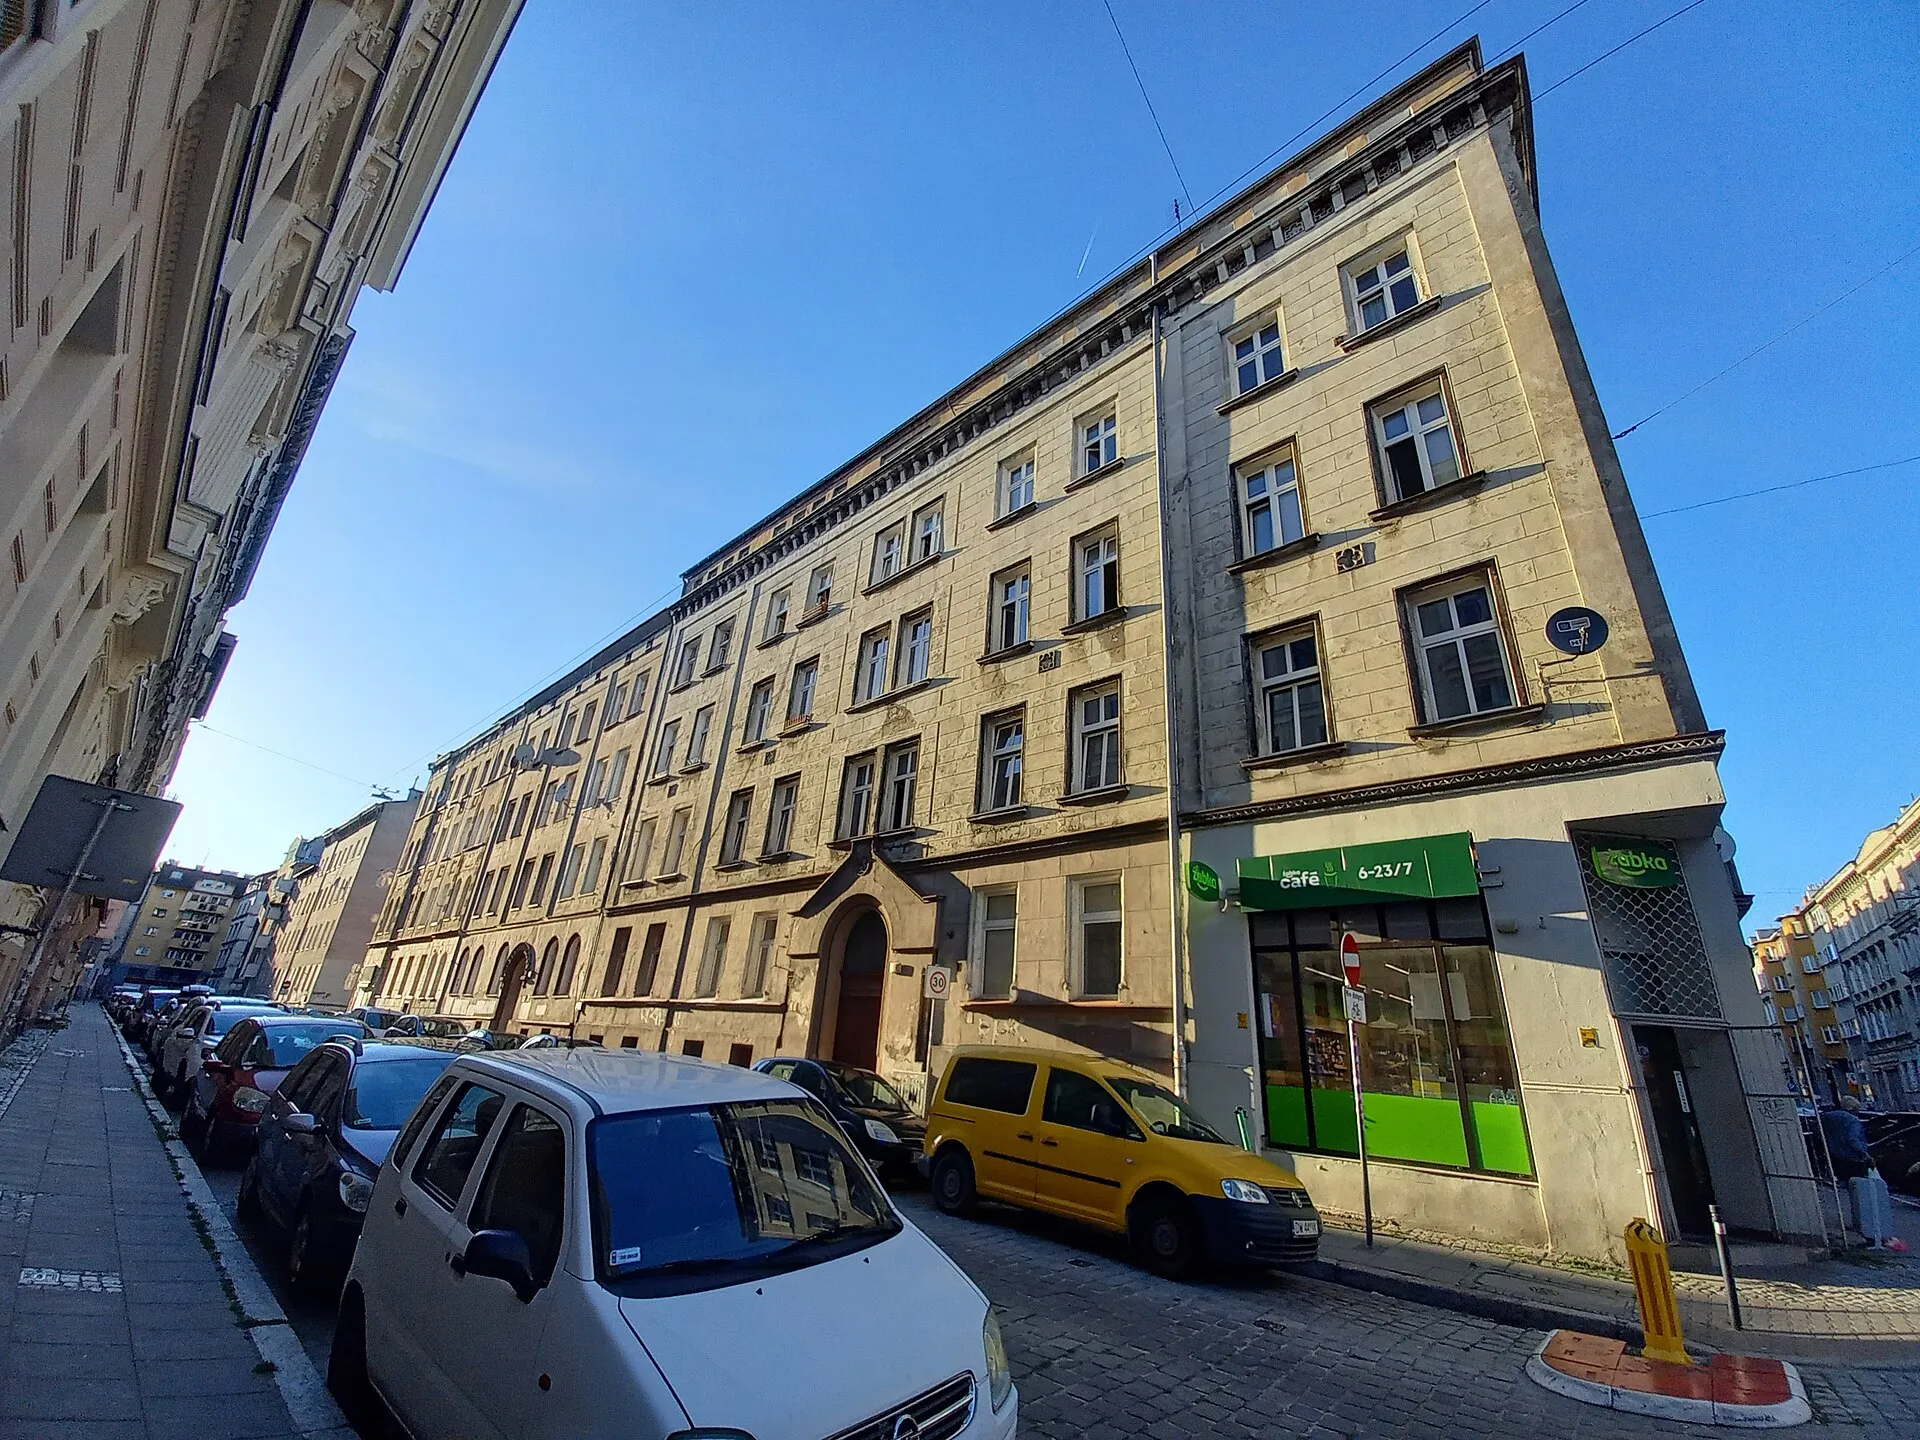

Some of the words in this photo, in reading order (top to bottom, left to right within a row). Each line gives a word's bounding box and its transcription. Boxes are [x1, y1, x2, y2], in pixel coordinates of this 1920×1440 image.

[1280, 870, 1320, 889] café
[1358, 861, 1413, 880] 6-23/7
[932, 976, 944, 988] 30
